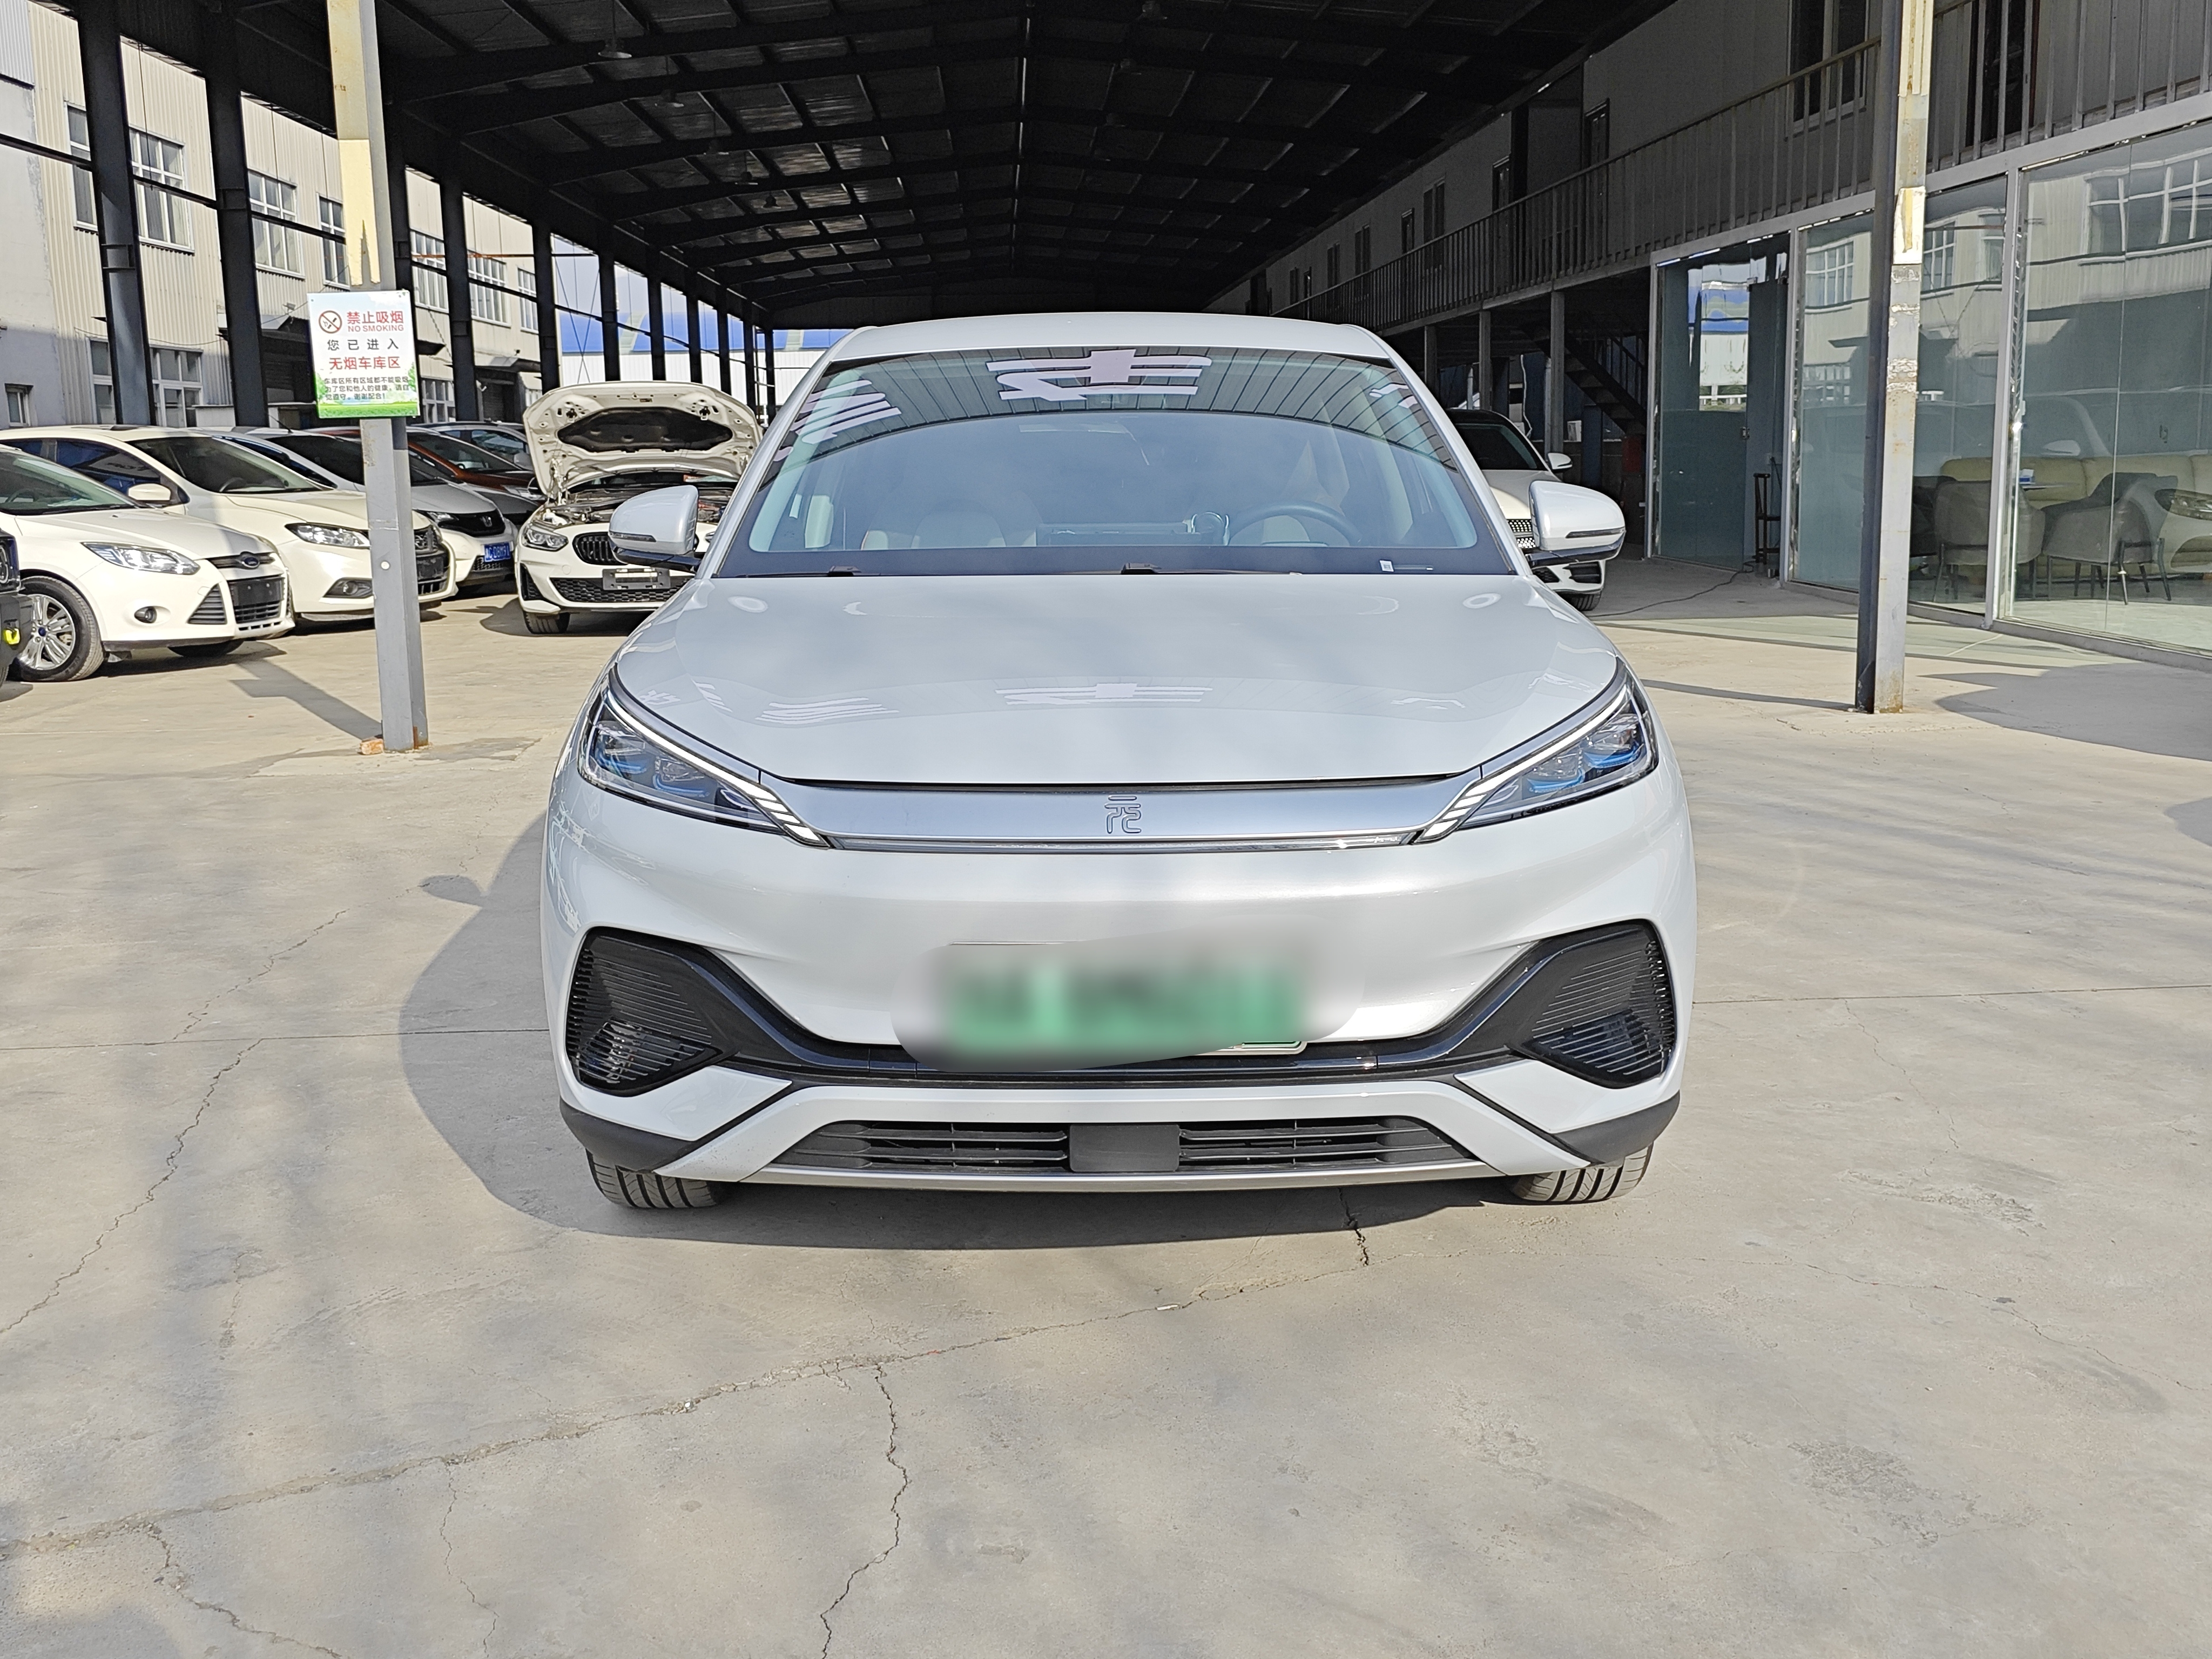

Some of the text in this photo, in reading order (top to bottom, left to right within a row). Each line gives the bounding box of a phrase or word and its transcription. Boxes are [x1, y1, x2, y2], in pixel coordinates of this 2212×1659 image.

[347, 311, 404, 324] 禁止吸烟
[327, 338, 399, 351] 您已进入
[328, 356, 401, 370] 无烟车库区
